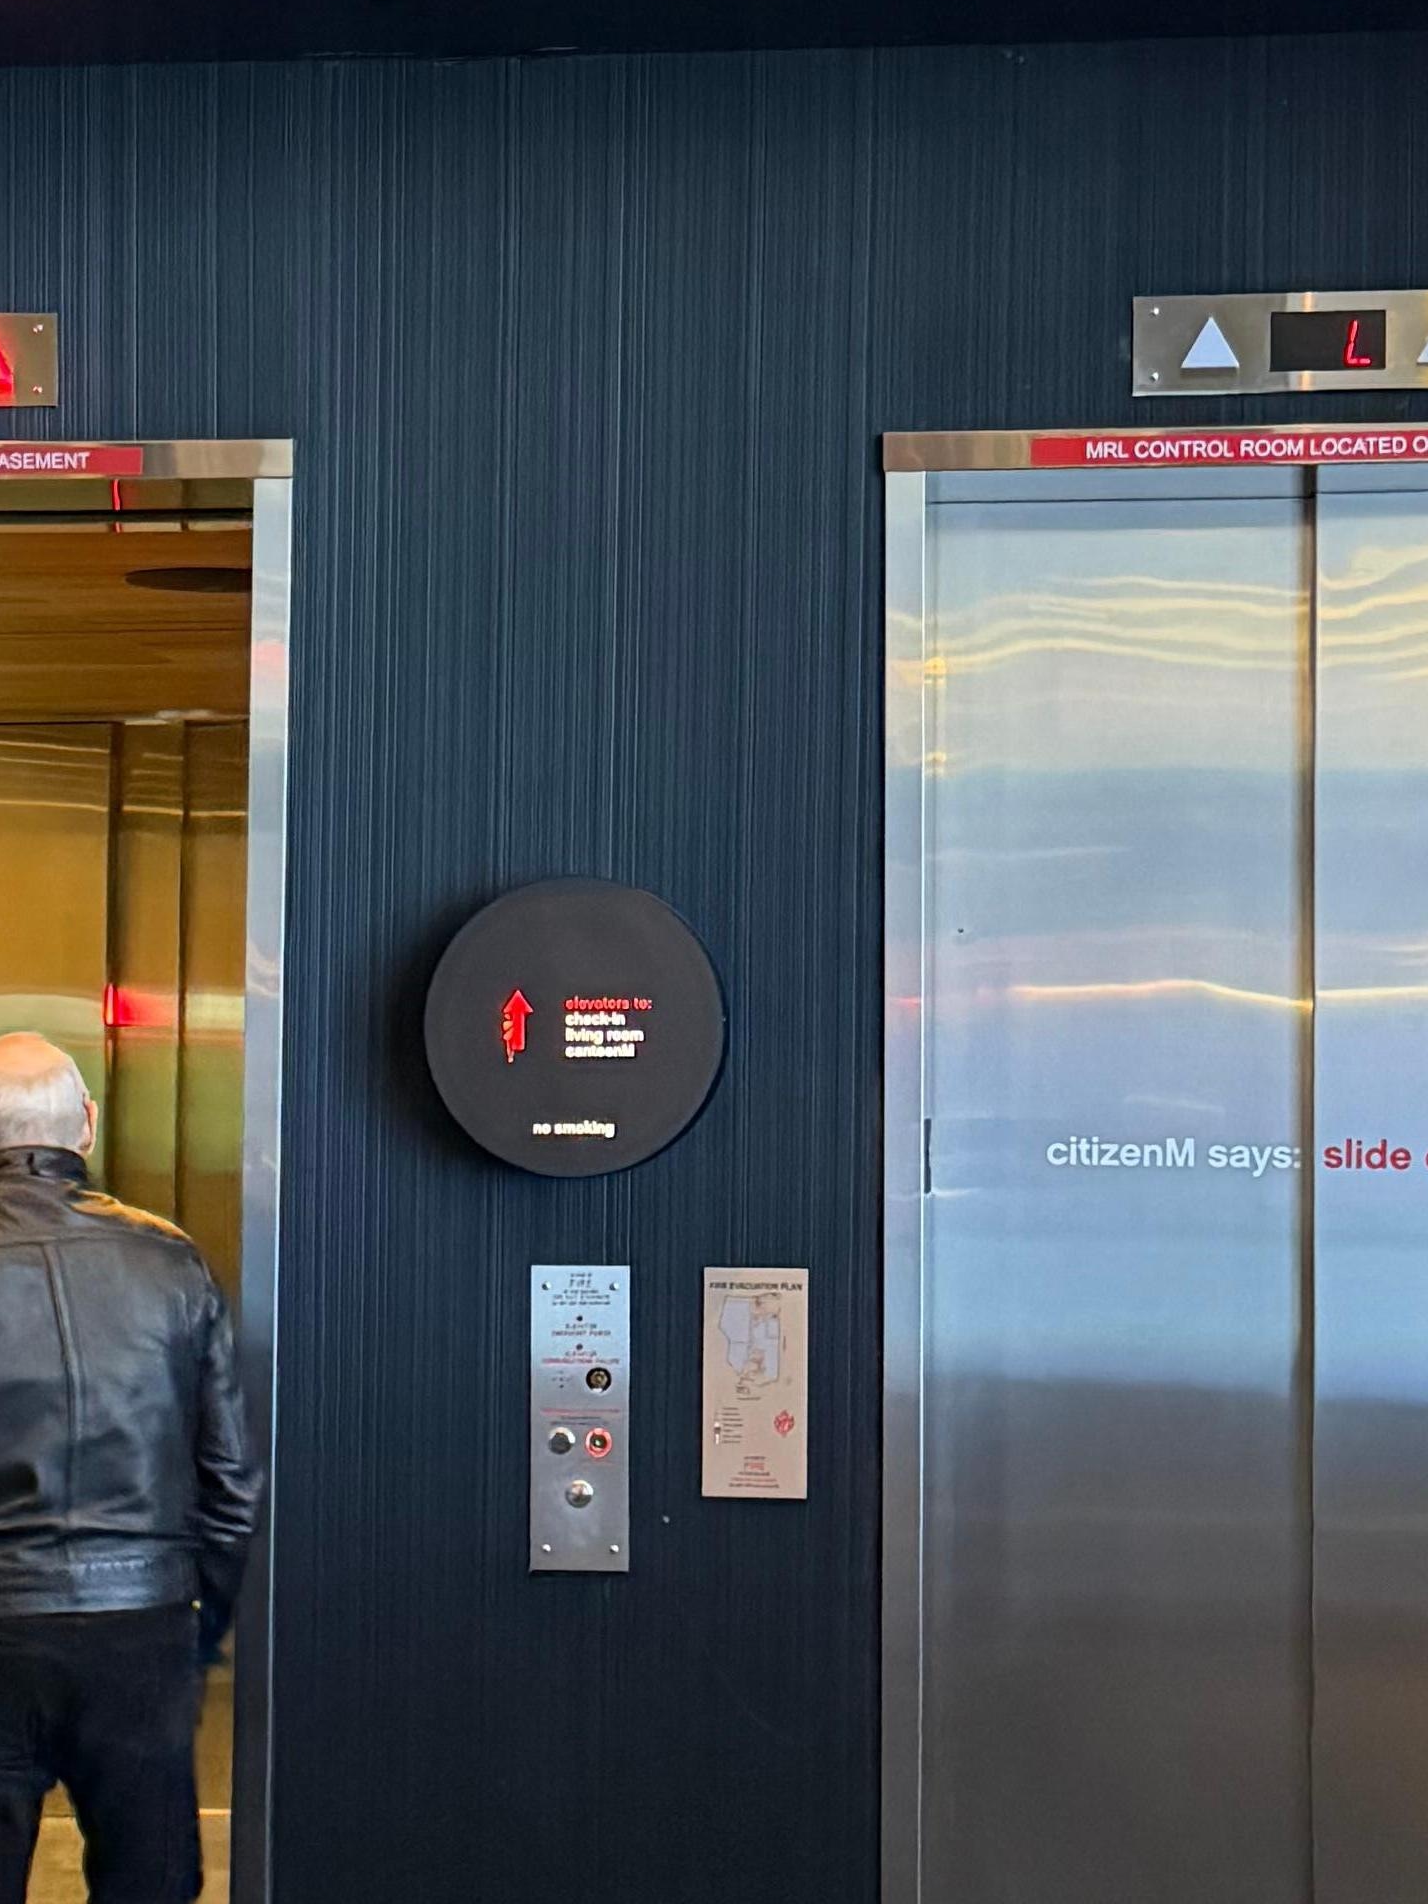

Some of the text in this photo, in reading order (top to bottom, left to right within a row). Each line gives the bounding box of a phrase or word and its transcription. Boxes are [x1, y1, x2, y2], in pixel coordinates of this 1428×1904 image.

[1343, 318, 1371, 367] L
[1085, 441, 1129, 460] MRL
[1134, 439, 1234, 459] CONTROL
[1239, 438, 1305, 457] ROOM
[1309, 437, 1405, 456] LOCATED
[565, 996, 653, 1010] elevators to:
[565, 1011, 626, 1026] check-in
[565, 1027, 645, 1045] living room
[532, 1120, 616, 1138] no smoking
[1046, 1135, 1195, 1168] citizenM
[1208, 1145, 1302, 1177] says:
[1323, 1139, 1411, 1171] slide
